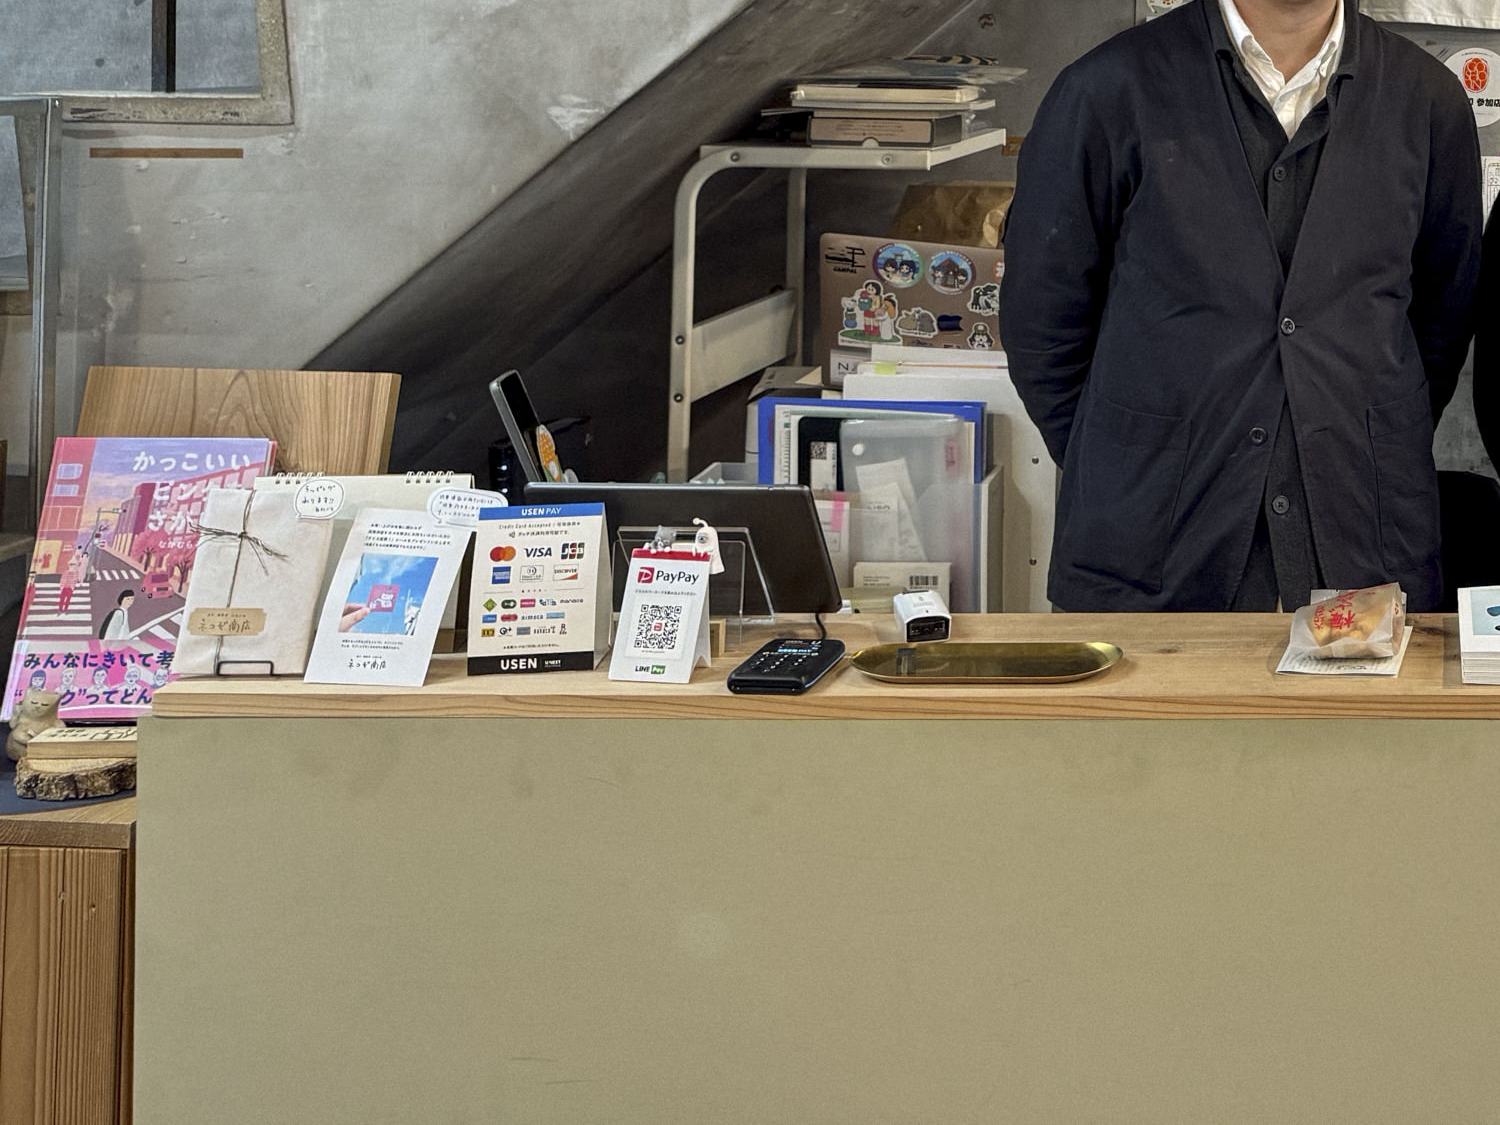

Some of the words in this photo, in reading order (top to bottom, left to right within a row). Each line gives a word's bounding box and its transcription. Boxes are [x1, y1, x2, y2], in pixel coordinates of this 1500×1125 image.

[133, 451, 249, 471] かっこいい
[521, 507, 544, 516] USEN
[545, 507, 562, 515] PAY
[524, 547, 553, 558] VISA
[655, 570, 700, 585] PayPay
[500, 658, 538, 671] USEN
[634, 665, 650, 673] LINE
[652, 665, 665, 674] Pay
